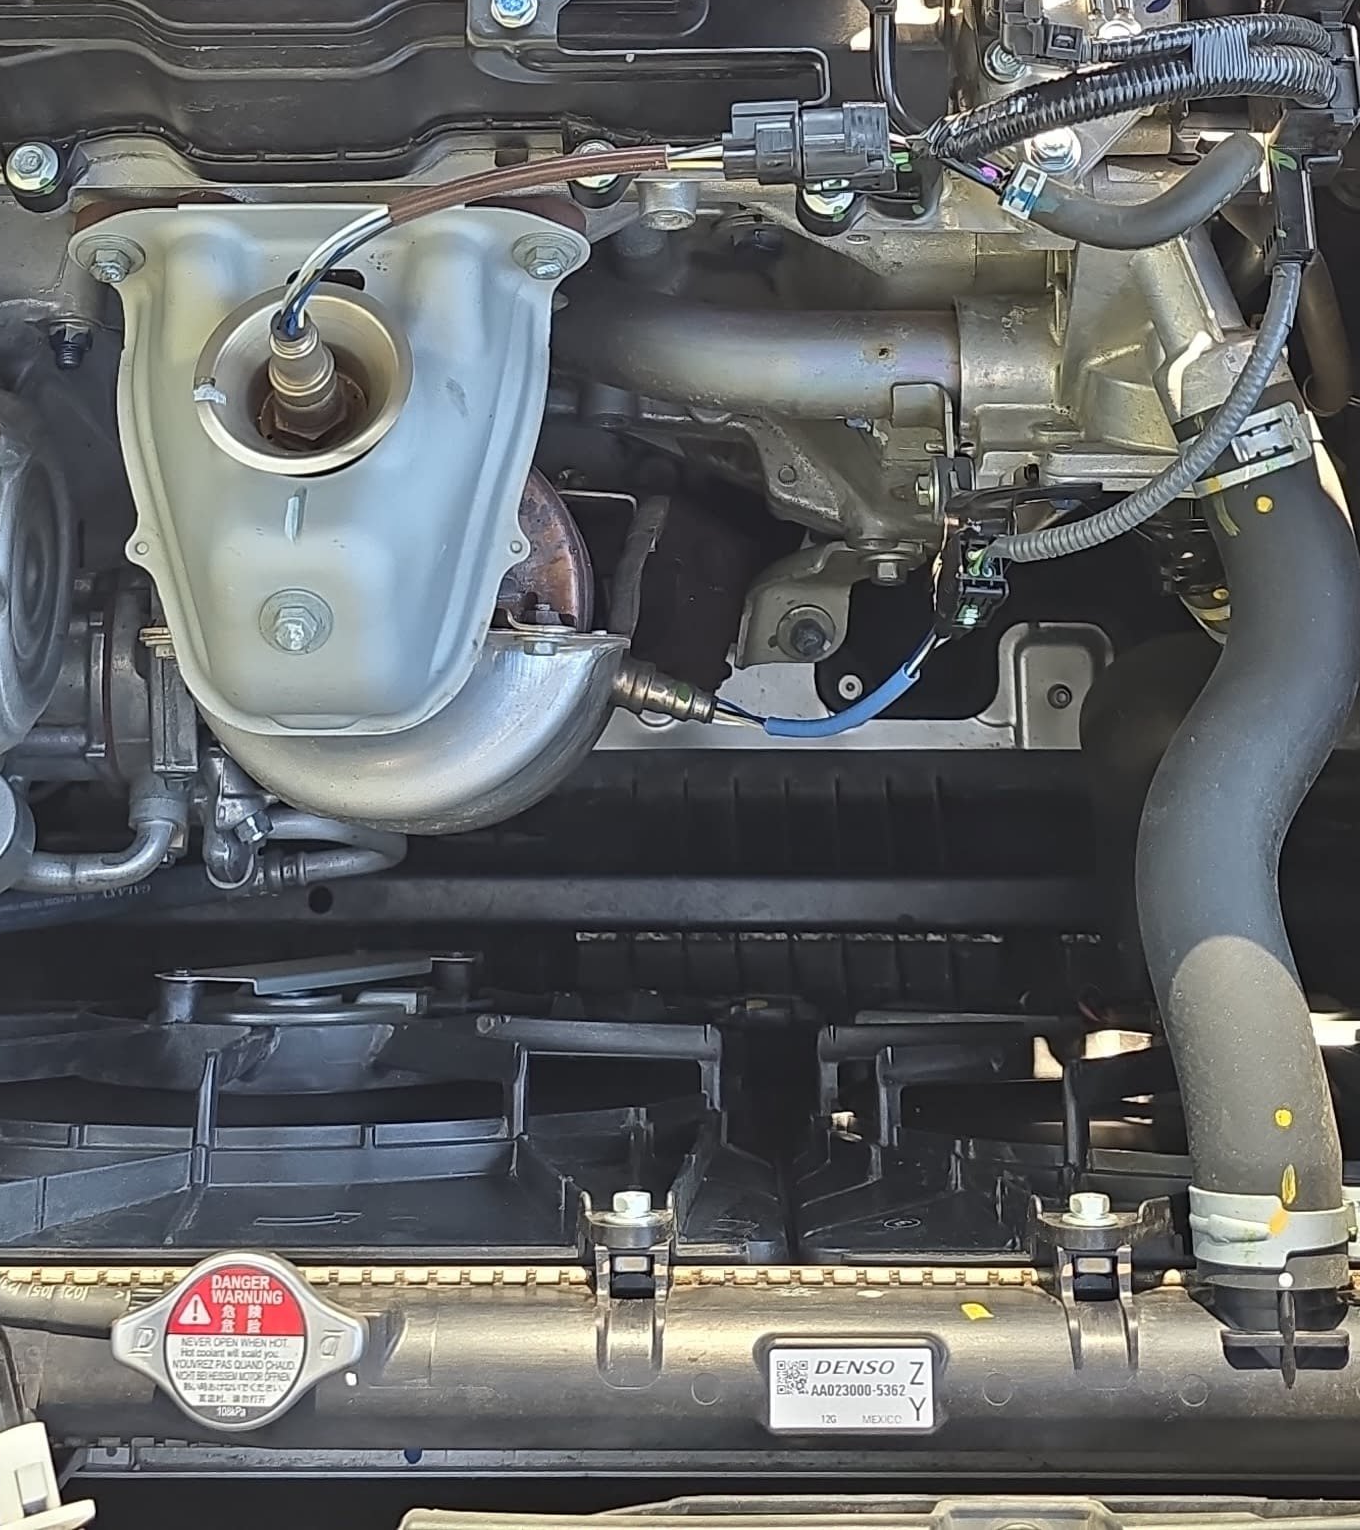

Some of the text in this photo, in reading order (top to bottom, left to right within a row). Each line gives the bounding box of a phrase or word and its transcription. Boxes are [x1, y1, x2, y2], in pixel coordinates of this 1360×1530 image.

[212, 1275, 270, 1289] DANGER
[212, 1290, 284, 1304] WARNUNG
[182, 1338, 212, 1347] NEVER
[214, 1338, 238, 1347] OPEN
[241, 1338, 267, 1347] WHEN
[181, 1349, 193, 1357] Hot
[197, 1349, 225, 1357] coolant
[227, 1349, 239, 1357] will
[241, 1349, 262, 1358] scald
[173, 1360, 213, 1369] N'OUVREZ
[216, 1360, 233, 1369] PAS
[234, 1360, 264, 1370] QUAND
[815, 1360, 924, 1385] DENSO Z
[811, 1384, 926, 1421] AA023000-5362 Y
[216, 1407, 247, 1417] 108kPa
[821, 1415, 902, 1424] 12G MEXICO
